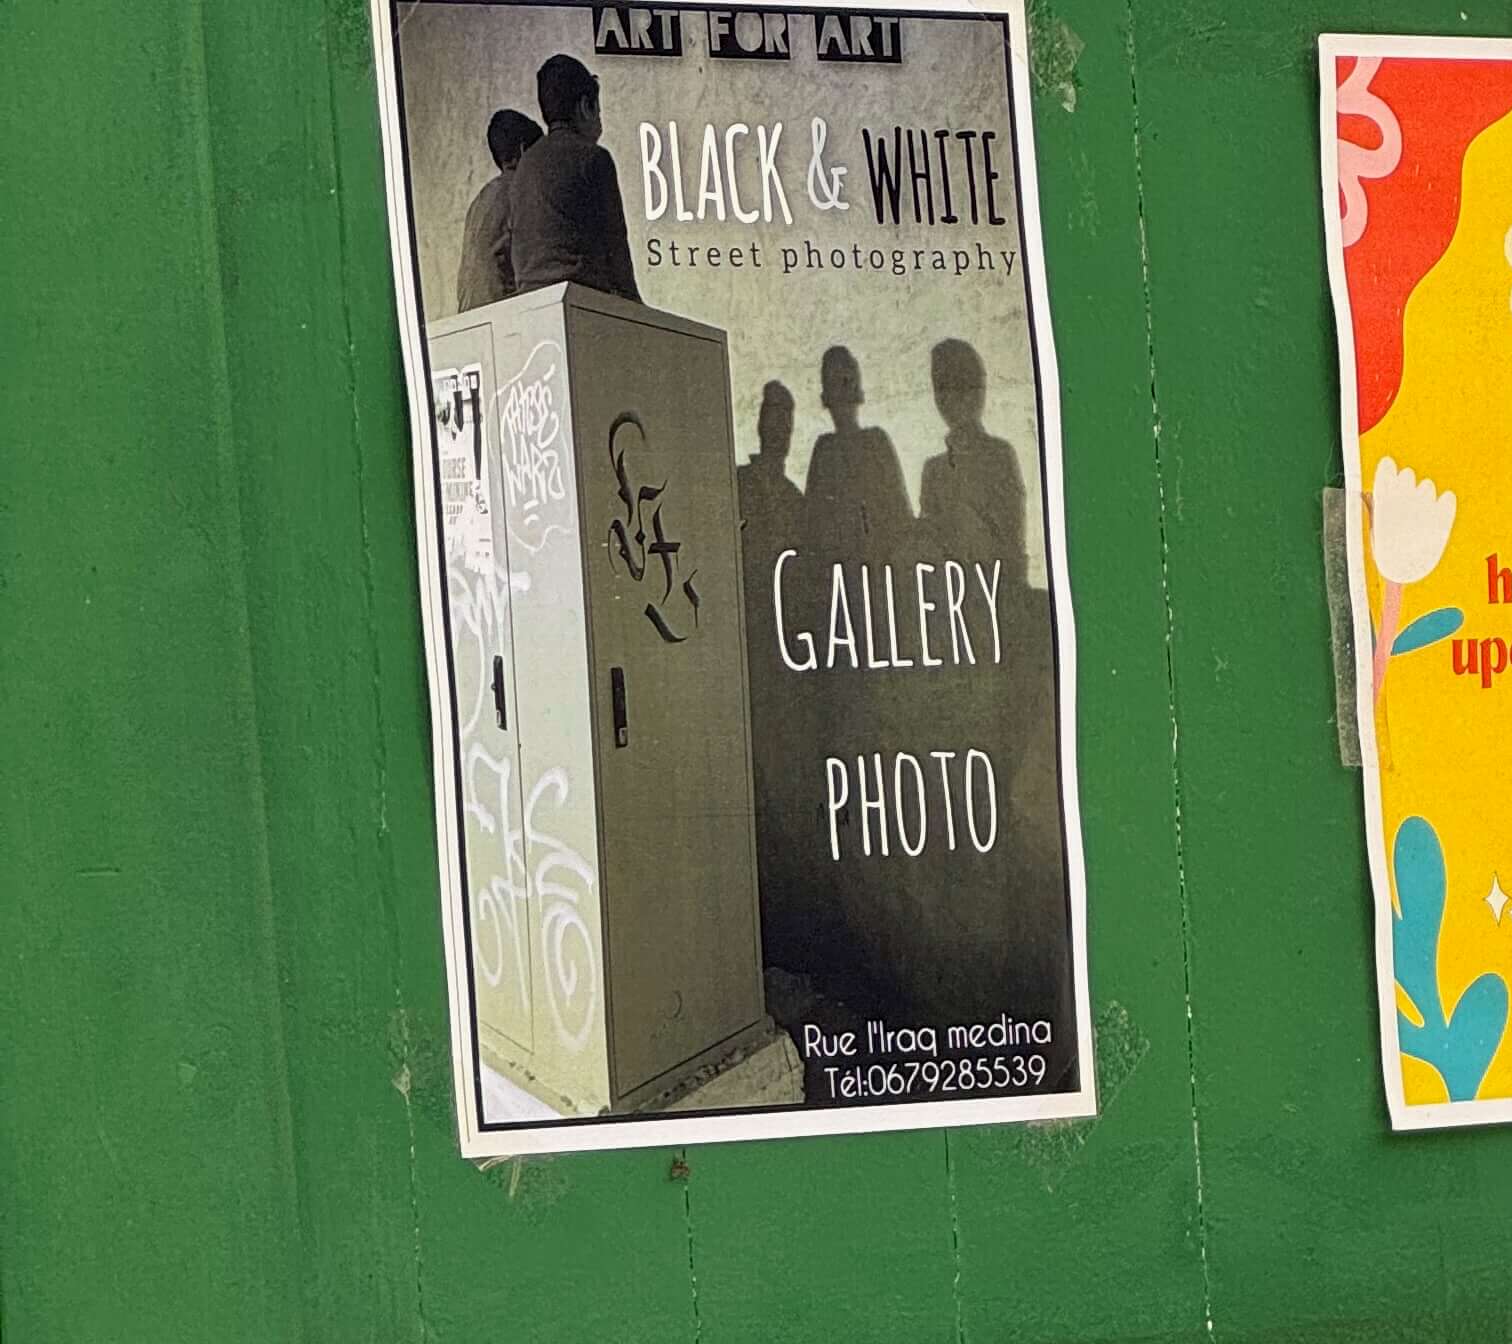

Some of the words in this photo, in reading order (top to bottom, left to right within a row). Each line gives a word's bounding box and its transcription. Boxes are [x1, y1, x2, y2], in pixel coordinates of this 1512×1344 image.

[596, 7, 680, 50] ART
[710, 10, 789, 54] FOR
[818, 15, 899, 57] ART
[639, 121, 793, 225] BLACK
[807, 116, 850, 210] &
[862, 126, 1006, 226] WHITE
[647, 238, 762, 267] Street
[783, 241, 1017, 275] photography
[773, 549, 1003, 672] GALLERY
[826, 748, 998, 861] PHOTO
[803, 1024, 857, 1058] Rue
[948, 1013, 1052, 1049] medina
[824, 1055, 1046, 1098] Tél:0679285539
